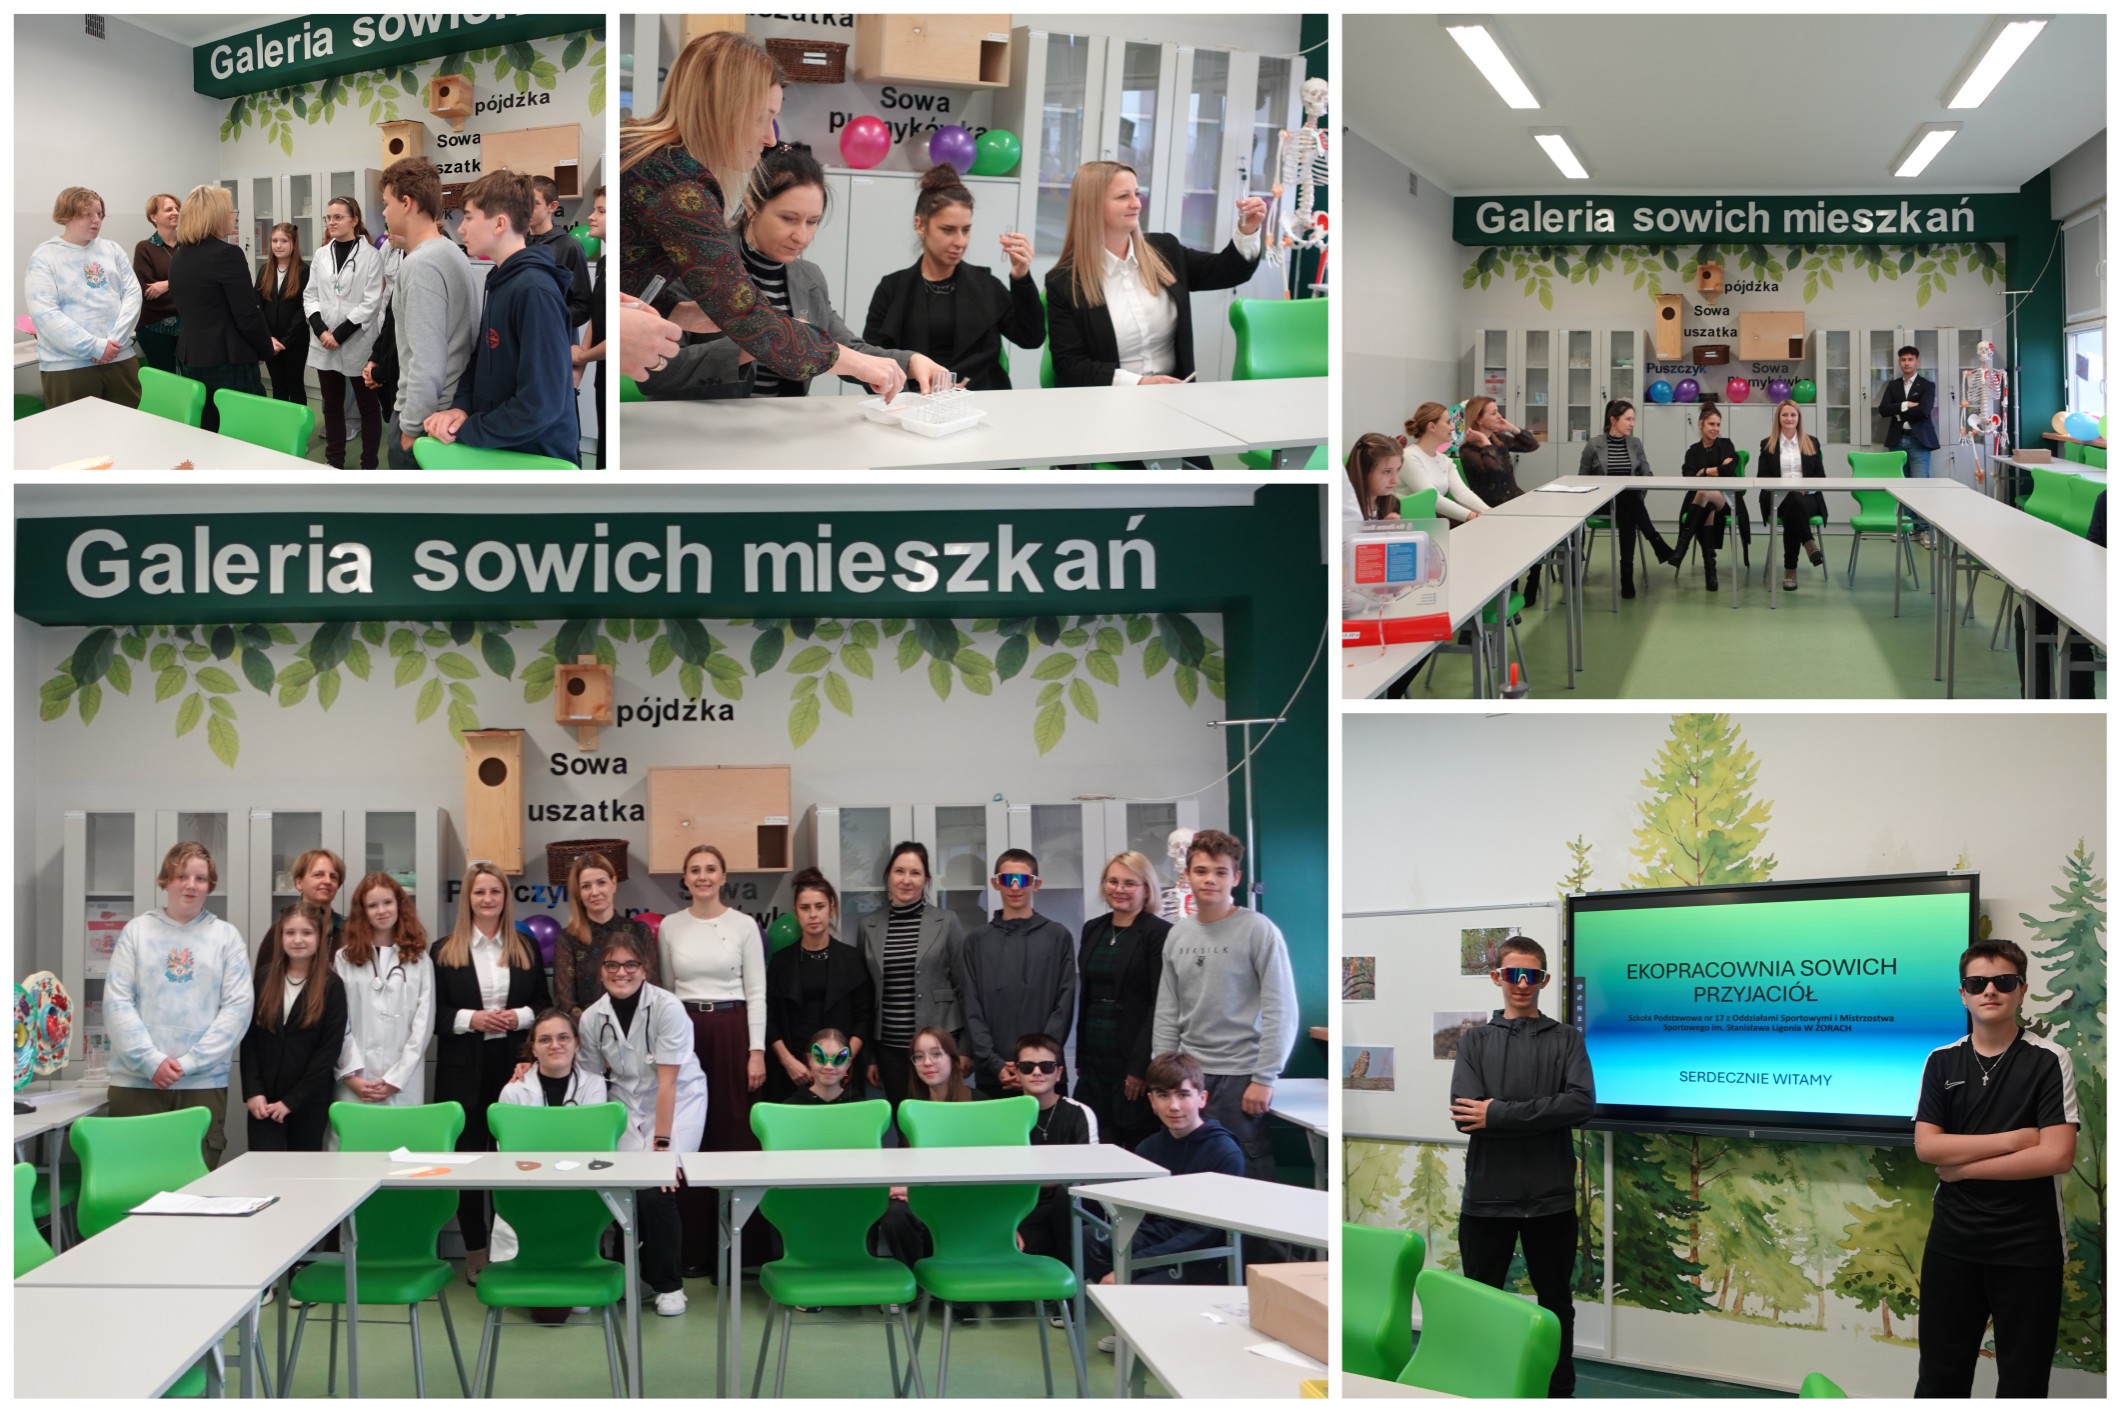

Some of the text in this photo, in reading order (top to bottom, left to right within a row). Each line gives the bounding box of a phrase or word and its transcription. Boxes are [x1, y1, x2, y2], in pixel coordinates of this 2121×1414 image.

[210, 21, 334, 80] Galeria
[475, 91, 551, 116] pójdźka
[880, 86, 951, 113] Sowa
[437, 133, 481, 148] Sowa
[436, 159, 481, 175] szatk
[1475, 197, 1976, 234] Galeria sowich mieszkań
[1724, 280, 1779, 294] pójdźka
[1694, 305, 1730, 316] Sowa
[1683, 326, 1738, 338] uszatka
[1646, 362, 1707, 377] Puszczyk
[1752, 362, 1789, 374] Sowa
[65, 514, 1158, 599] Galeria sowich mieszkań
[616, 697, 735, 728] pójdźka
[549, 752, 628, 776] Sowa
[527, 799, 646, 823] uszatka
[678, 878, 758, 901] Swa
[1627, 957, 1897, 980] EKOPRACOWNIA SOWICH
[1694, 981, 1818, 1003] PRZYJACIÓŁ
[1628, 1014, 1652, 1022] Szkoła
[1654, 1014, 1702, 1022] Podstawowa
[1715, 1014, 1724, 1022] 17
[1732, 1014, 1779, 1023] Oddziałami
[1780, 1013, 1832, 1024] Sportowymi
[1834, 1014, 1838, 1022] i
[1839, 1014, 1894, 1023] Mistrzostwa
[1663, 1024, 1710, 1033] Sportowego
[1726, 1023, 1770, 1032] Stanisława
[1772, 1023, 1802, 1033] Ligonia
[1804, 1024, 1813, 1032] W
[1679, 1070, 1832, 1087] SERDECZNIE WITAMY
